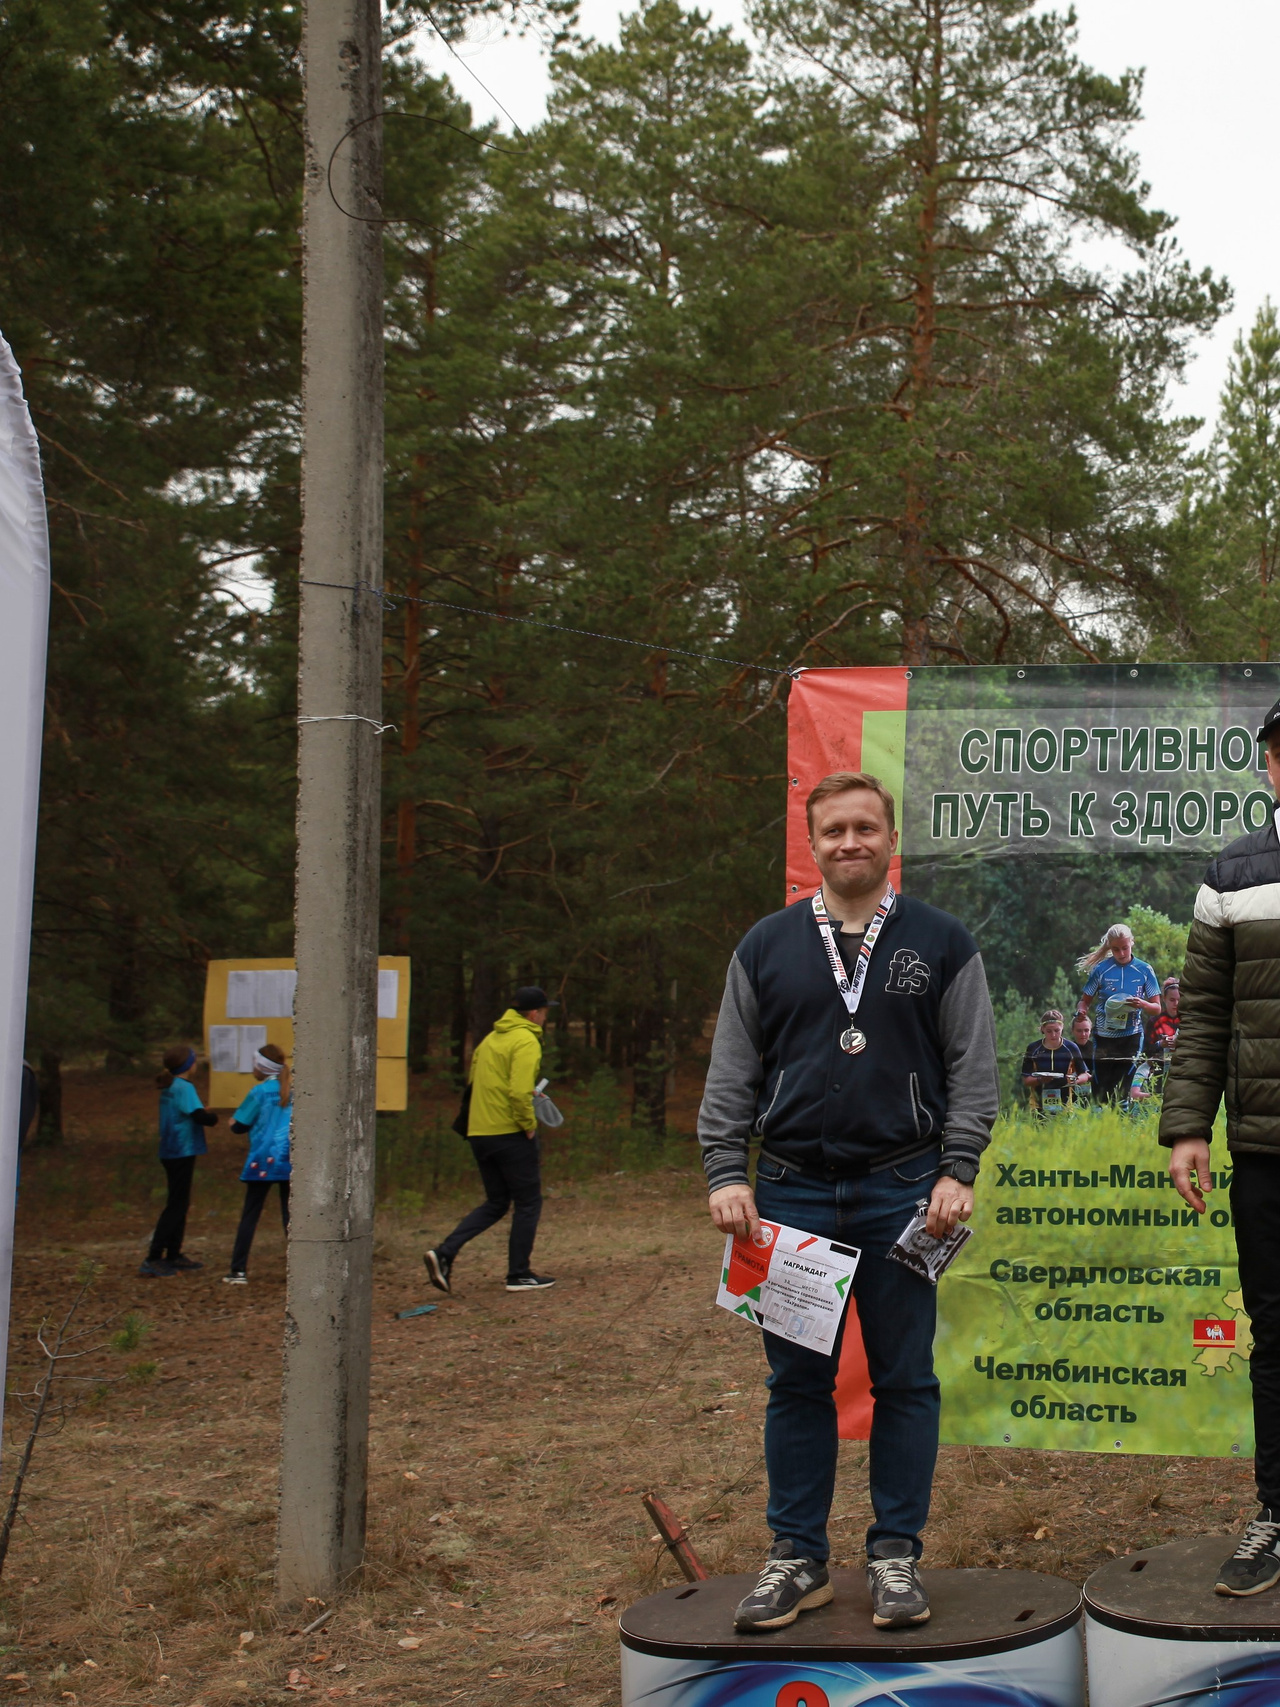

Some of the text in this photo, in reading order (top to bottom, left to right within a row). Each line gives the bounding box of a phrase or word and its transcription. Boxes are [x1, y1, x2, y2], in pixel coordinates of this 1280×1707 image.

[931, 792, 1051, 839] ПУТЬ
[1069, 791, 1095, 837] К
[996, 1203, 1199, 1228] автономный
[734, 1250, 765, 1273] ГРАМОТА
[783, 1260, 828, 1278] НАГРАЖДАЕТ
[989, 1258, 1221, 1289] Свердловская
[1034, 1297, 1165, 1324] область
[974, 1356, 1187, 1387] Челябинская
[1011, 1395, 1137, 1423] область
